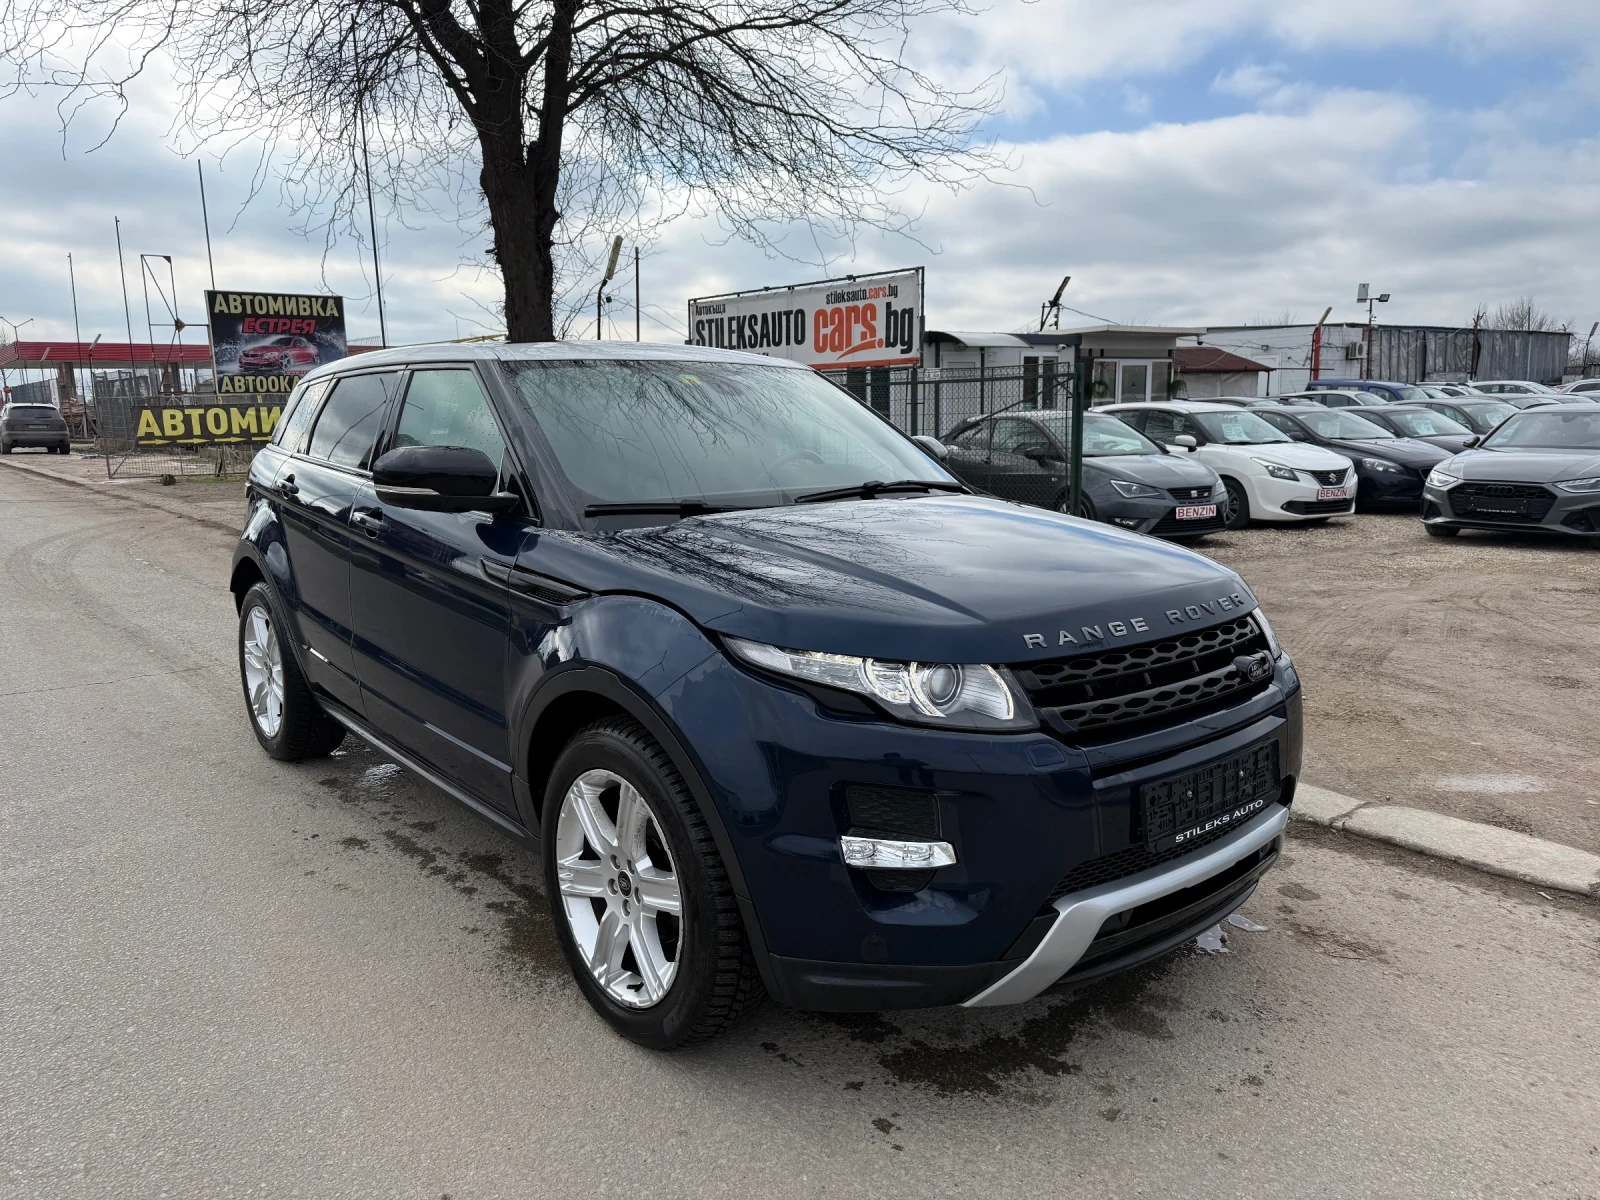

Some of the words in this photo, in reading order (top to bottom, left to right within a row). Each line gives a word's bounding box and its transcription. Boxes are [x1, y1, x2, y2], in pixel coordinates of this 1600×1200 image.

[214, 293, 339, 317] АВТОМИВКА
[825, 284, 898, 305] stileksauto.cars.bg
[695, 303, 726, 316] Автокъща
[242, 317, 316, 334] ЕСТРЕЯ
[695, 308, 806, 350] STILEKSAUTO
[813, 301, 914, 355] cars.bg
[1320, 488, 1348, 498] BENZIN
[1177, 506, 1216, 518] BENZIN
[1022, 617, 1150, 649] RANGE
[1165, 592, 1245, 625] ROVER
[1175, 814, 1230, 843] STILEKS
[1232, 799, 1264, 820] AUTO
